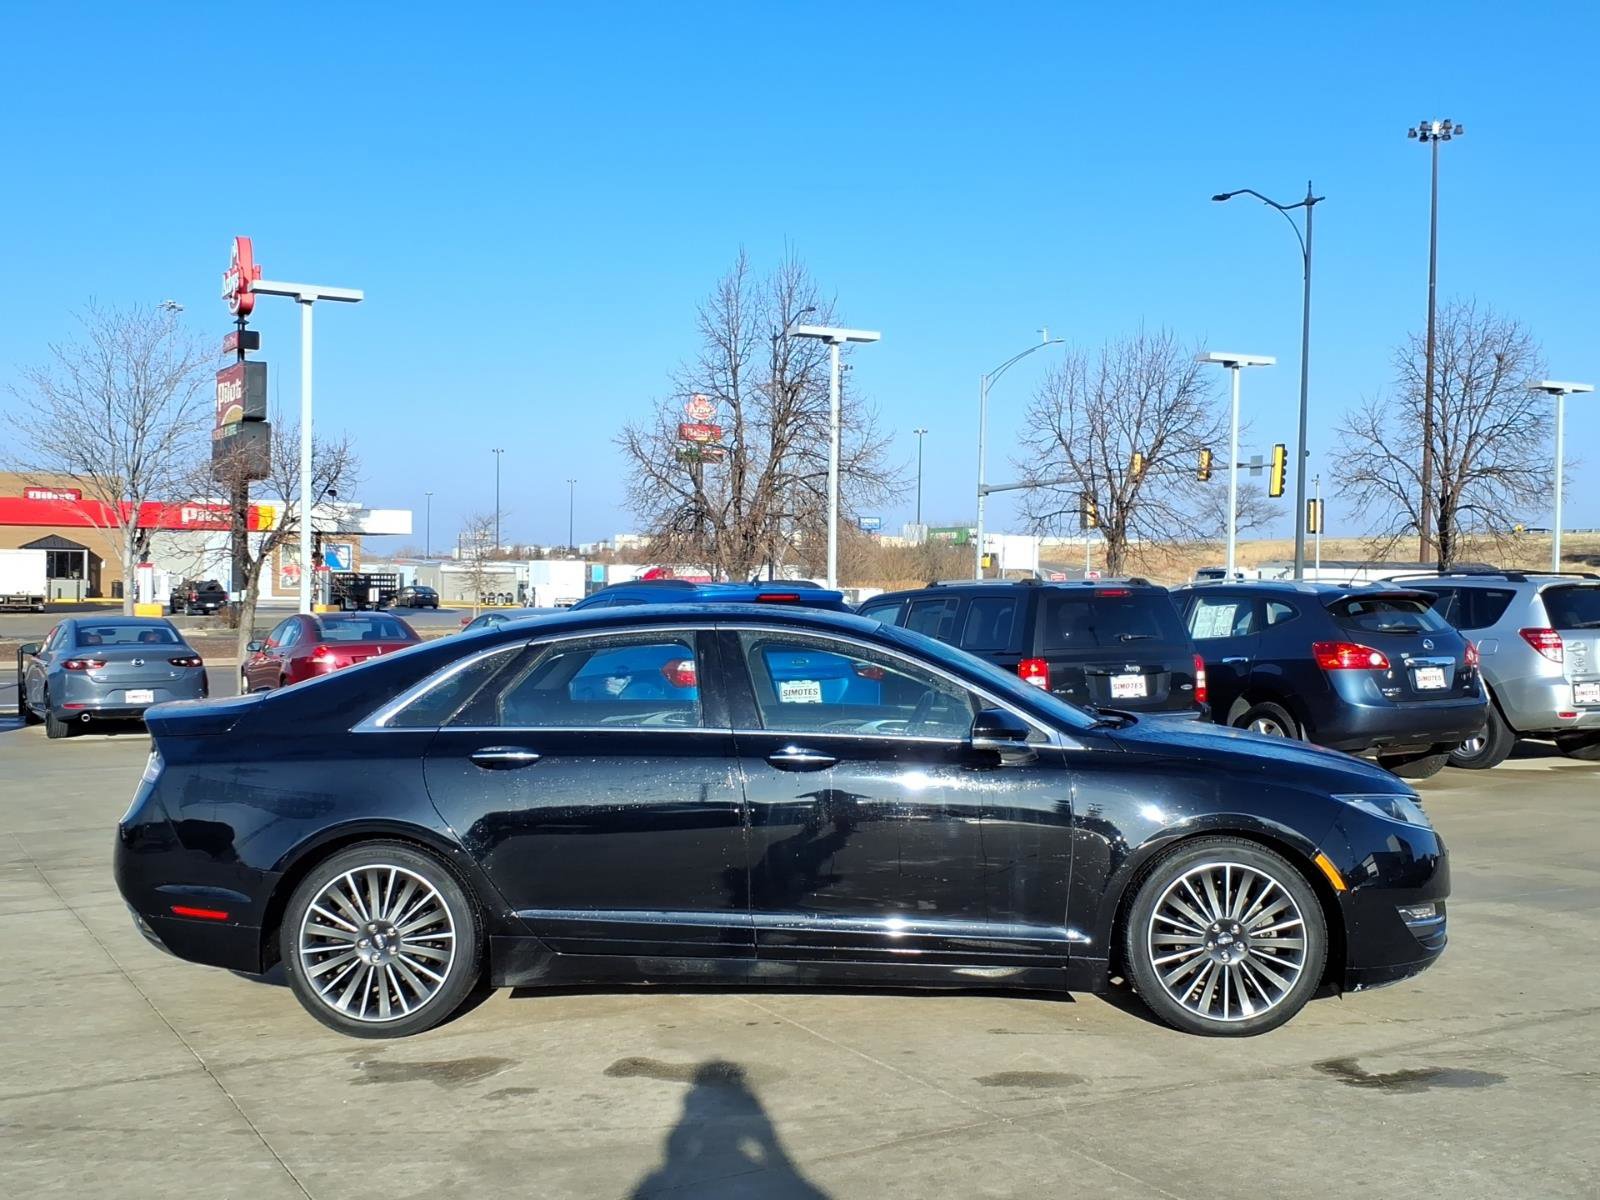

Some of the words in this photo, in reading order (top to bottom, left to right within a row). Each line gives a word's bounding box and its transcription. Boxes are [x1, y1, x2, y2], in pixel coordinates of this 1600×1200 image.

[217, 378, 242, 412] Pilot
[1124, 664, 1141, 673] Jeep
[1113, 682, 1144, 690] SIMOTES
[783, 688, 819, 697] SIMOTES
